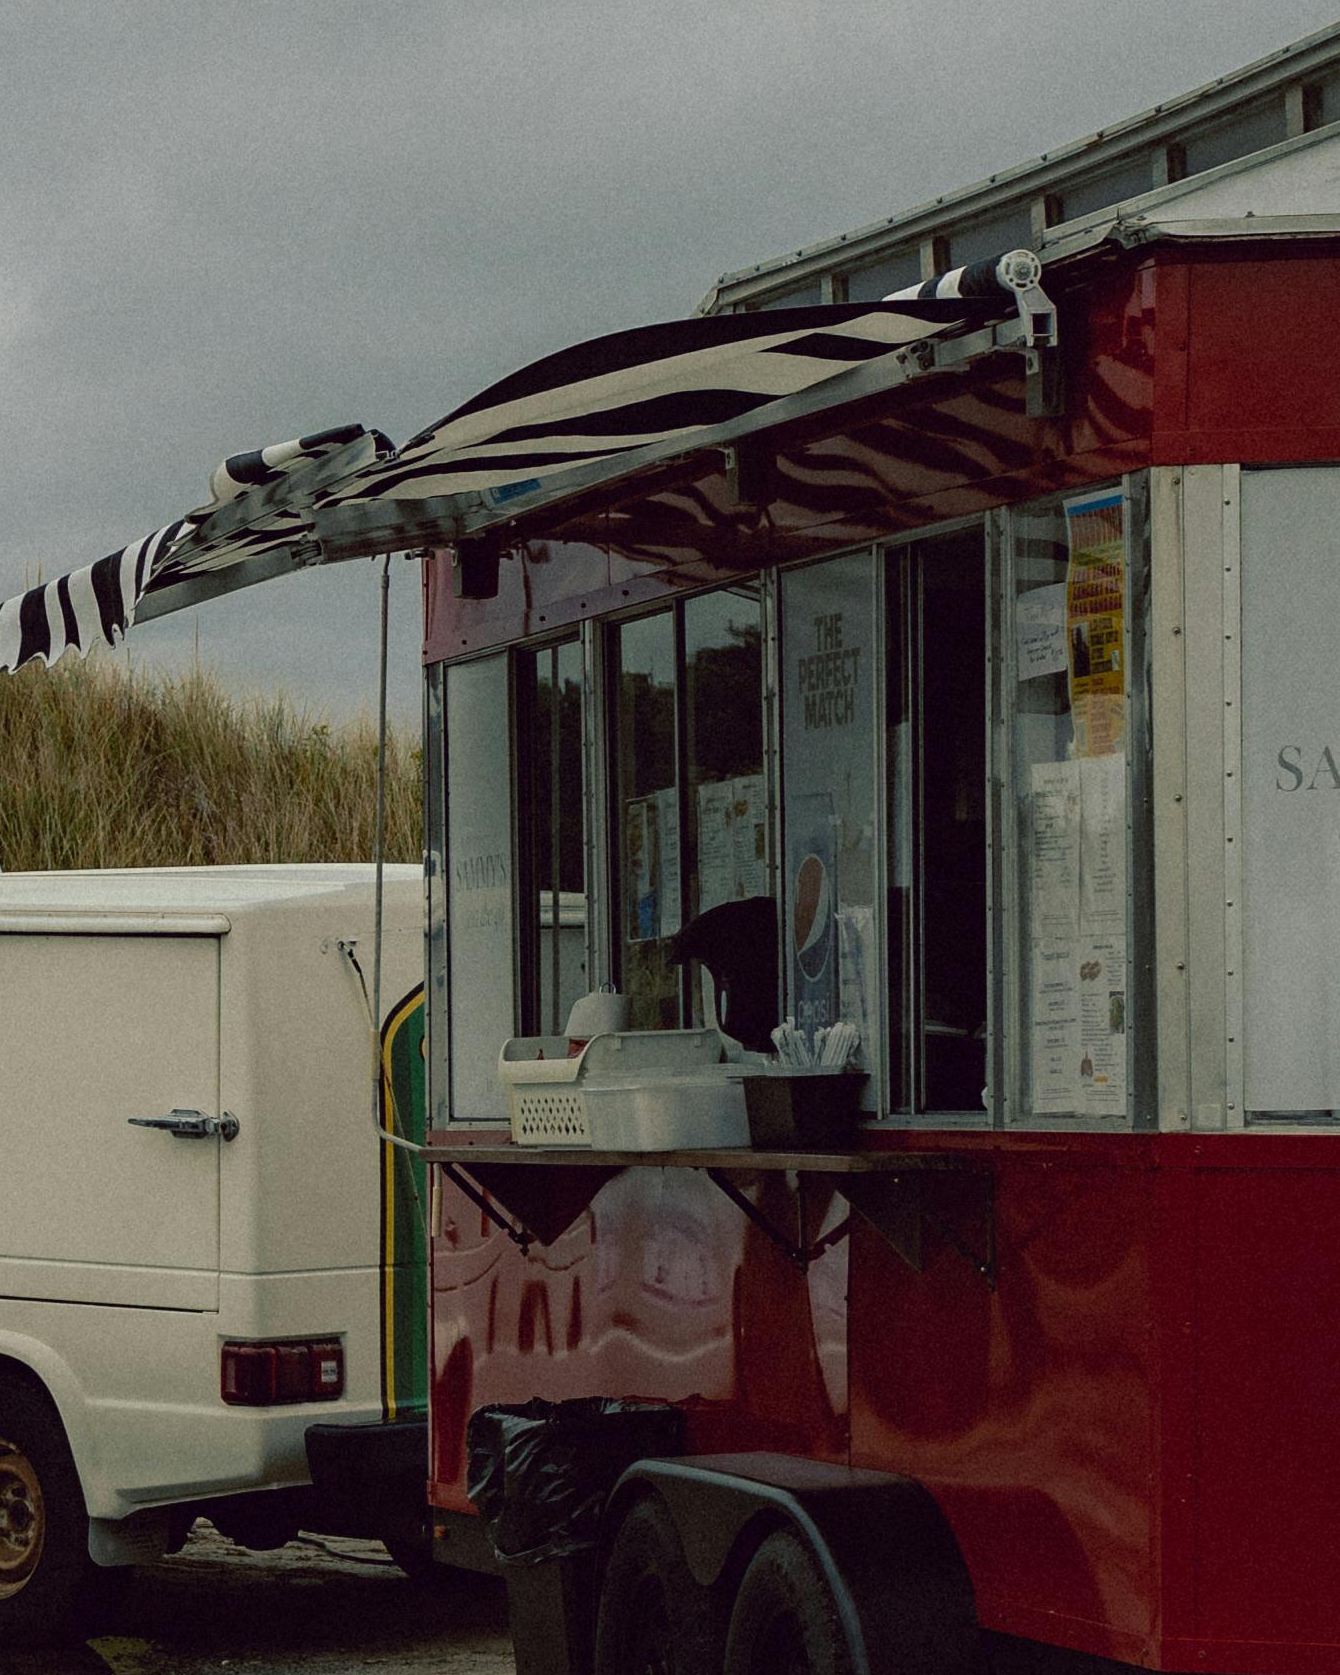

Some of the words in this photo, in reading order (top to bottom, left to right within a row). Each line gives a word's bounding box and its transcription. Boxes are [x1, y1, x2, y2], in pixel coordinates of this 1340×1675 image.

[814, 613, 842, 651] THE
[798, 647, 860, 693] PERFECT
[804, 687, 854, 730] MATCH
[797, 992, 830, 1028] pepsi
